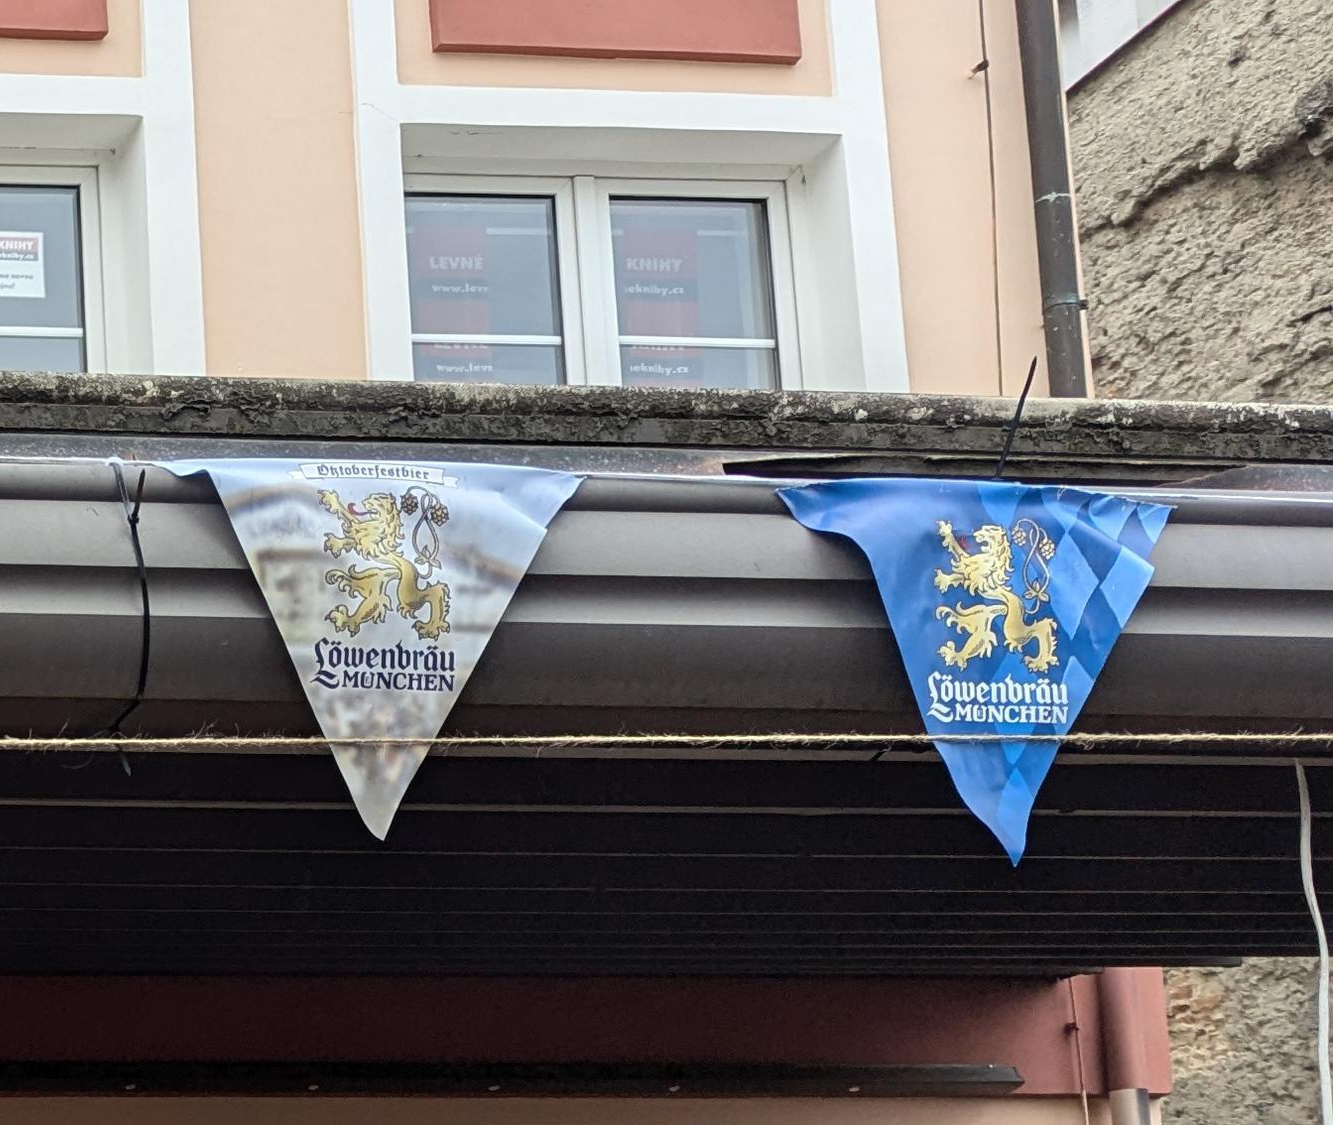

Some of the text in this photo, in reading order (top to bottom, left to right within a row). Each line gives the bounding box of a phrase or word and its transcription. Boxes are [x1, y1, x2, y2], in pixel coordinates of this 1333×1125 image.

[429, 253, 683, 273] LEVNÉ KNIHY
[310, 637, 456, 689] Löwenbräu
[926, 670, 1069, 723] Löwenbräu
